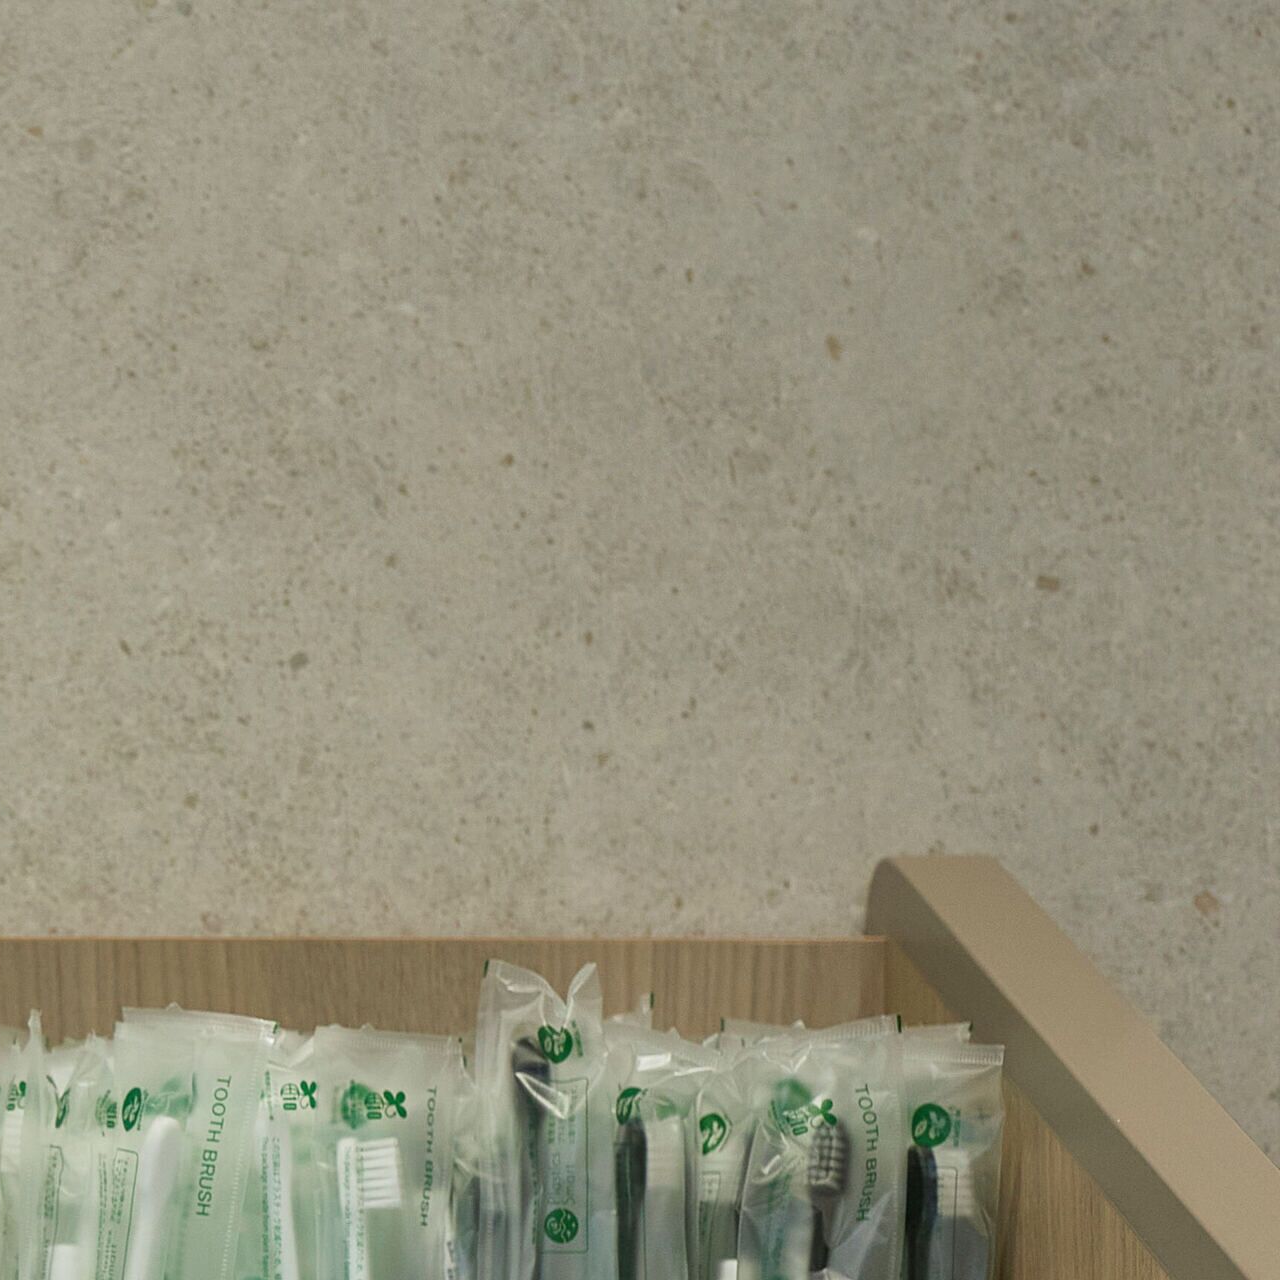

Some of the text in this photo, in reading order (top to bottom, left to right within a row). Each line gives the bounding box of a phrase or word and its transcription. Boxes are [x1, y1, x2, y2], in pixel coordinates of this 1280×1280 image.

[195, 1075, 232, 1217] TOOTH BRUSH
[420, 1085, 437, 1227] TOOTH BRUSH
[855, 1083, 879, 1222] TOOTH BRUSH
